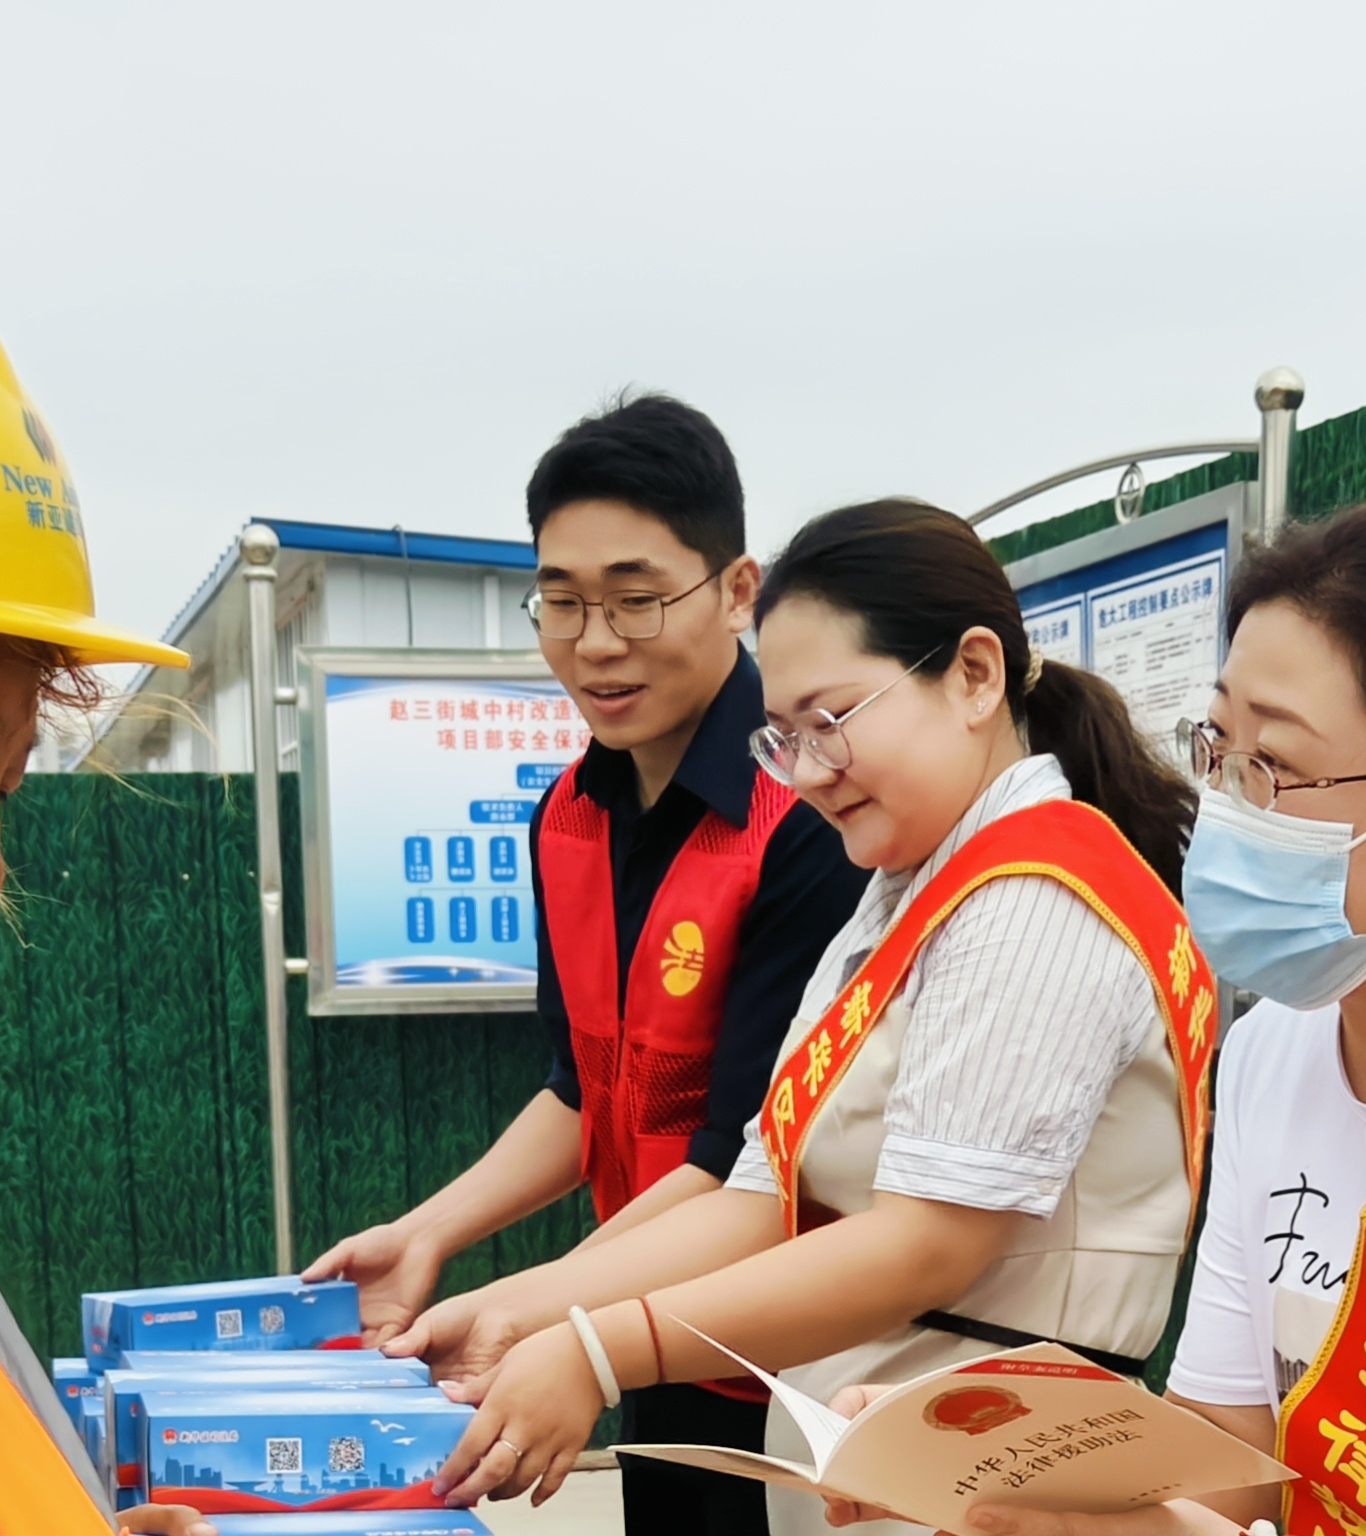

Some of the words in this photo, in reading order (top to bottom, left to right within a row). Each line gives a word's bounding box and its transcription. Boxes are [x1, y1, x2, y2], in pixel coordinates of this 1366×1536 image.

[0, 464, 53, 499] New
[954, 1409, 1145, 1498] 中华人民共和国
[1001, 1429, 1143, 1489] 法律援助法
